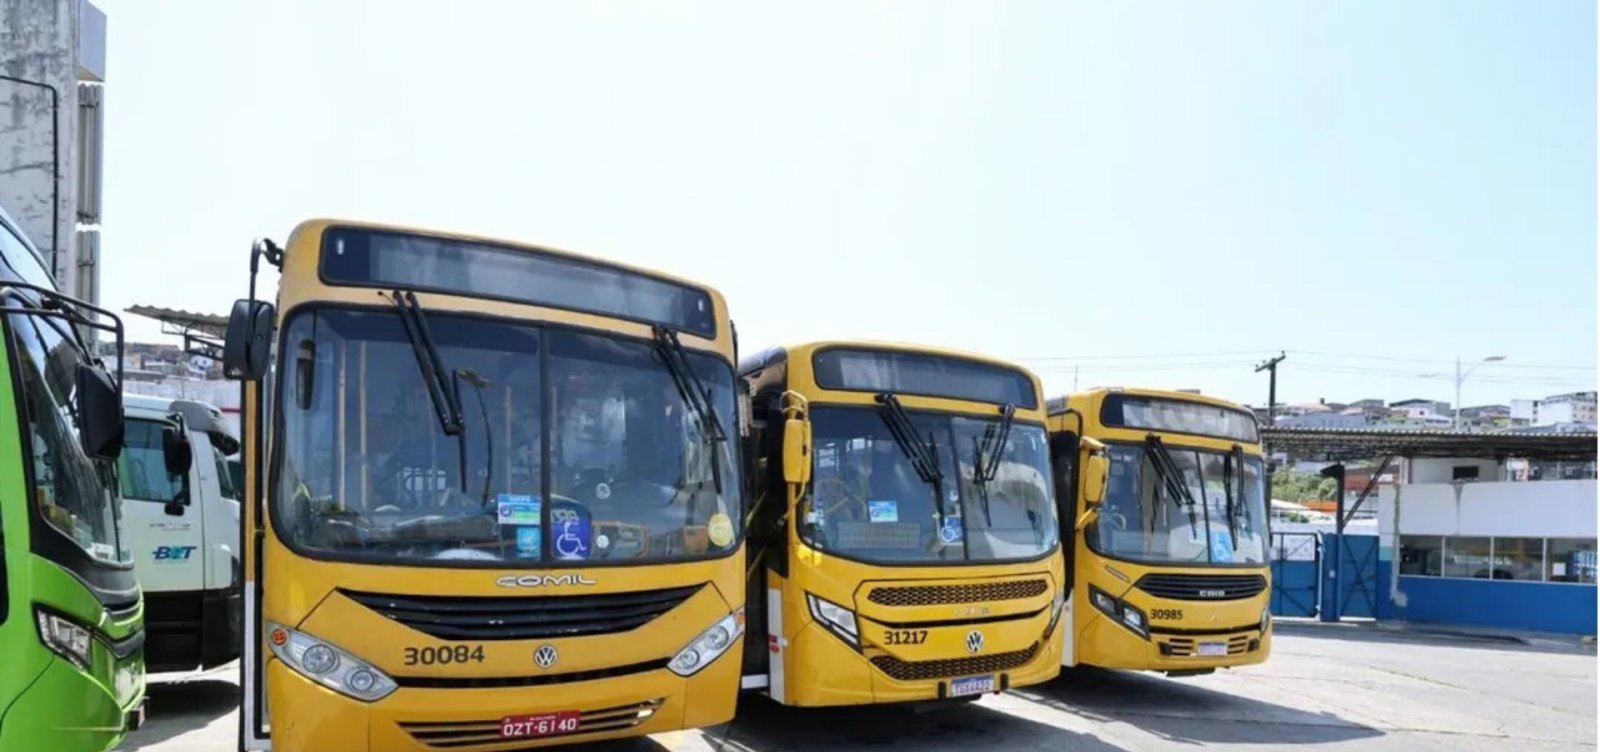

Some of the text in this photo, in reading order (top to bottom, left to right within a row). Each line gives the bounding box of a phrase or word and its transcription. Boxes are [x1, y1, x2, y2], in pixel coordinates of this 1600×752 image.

[496, 574, 597, 588] COMIL
[1150, 608, 1183, 621] 30985
[884, 630, 928, 646] 31217
[403, 644, 485, 667] 30084
[503, 717, 577, 737] OZT-6140
